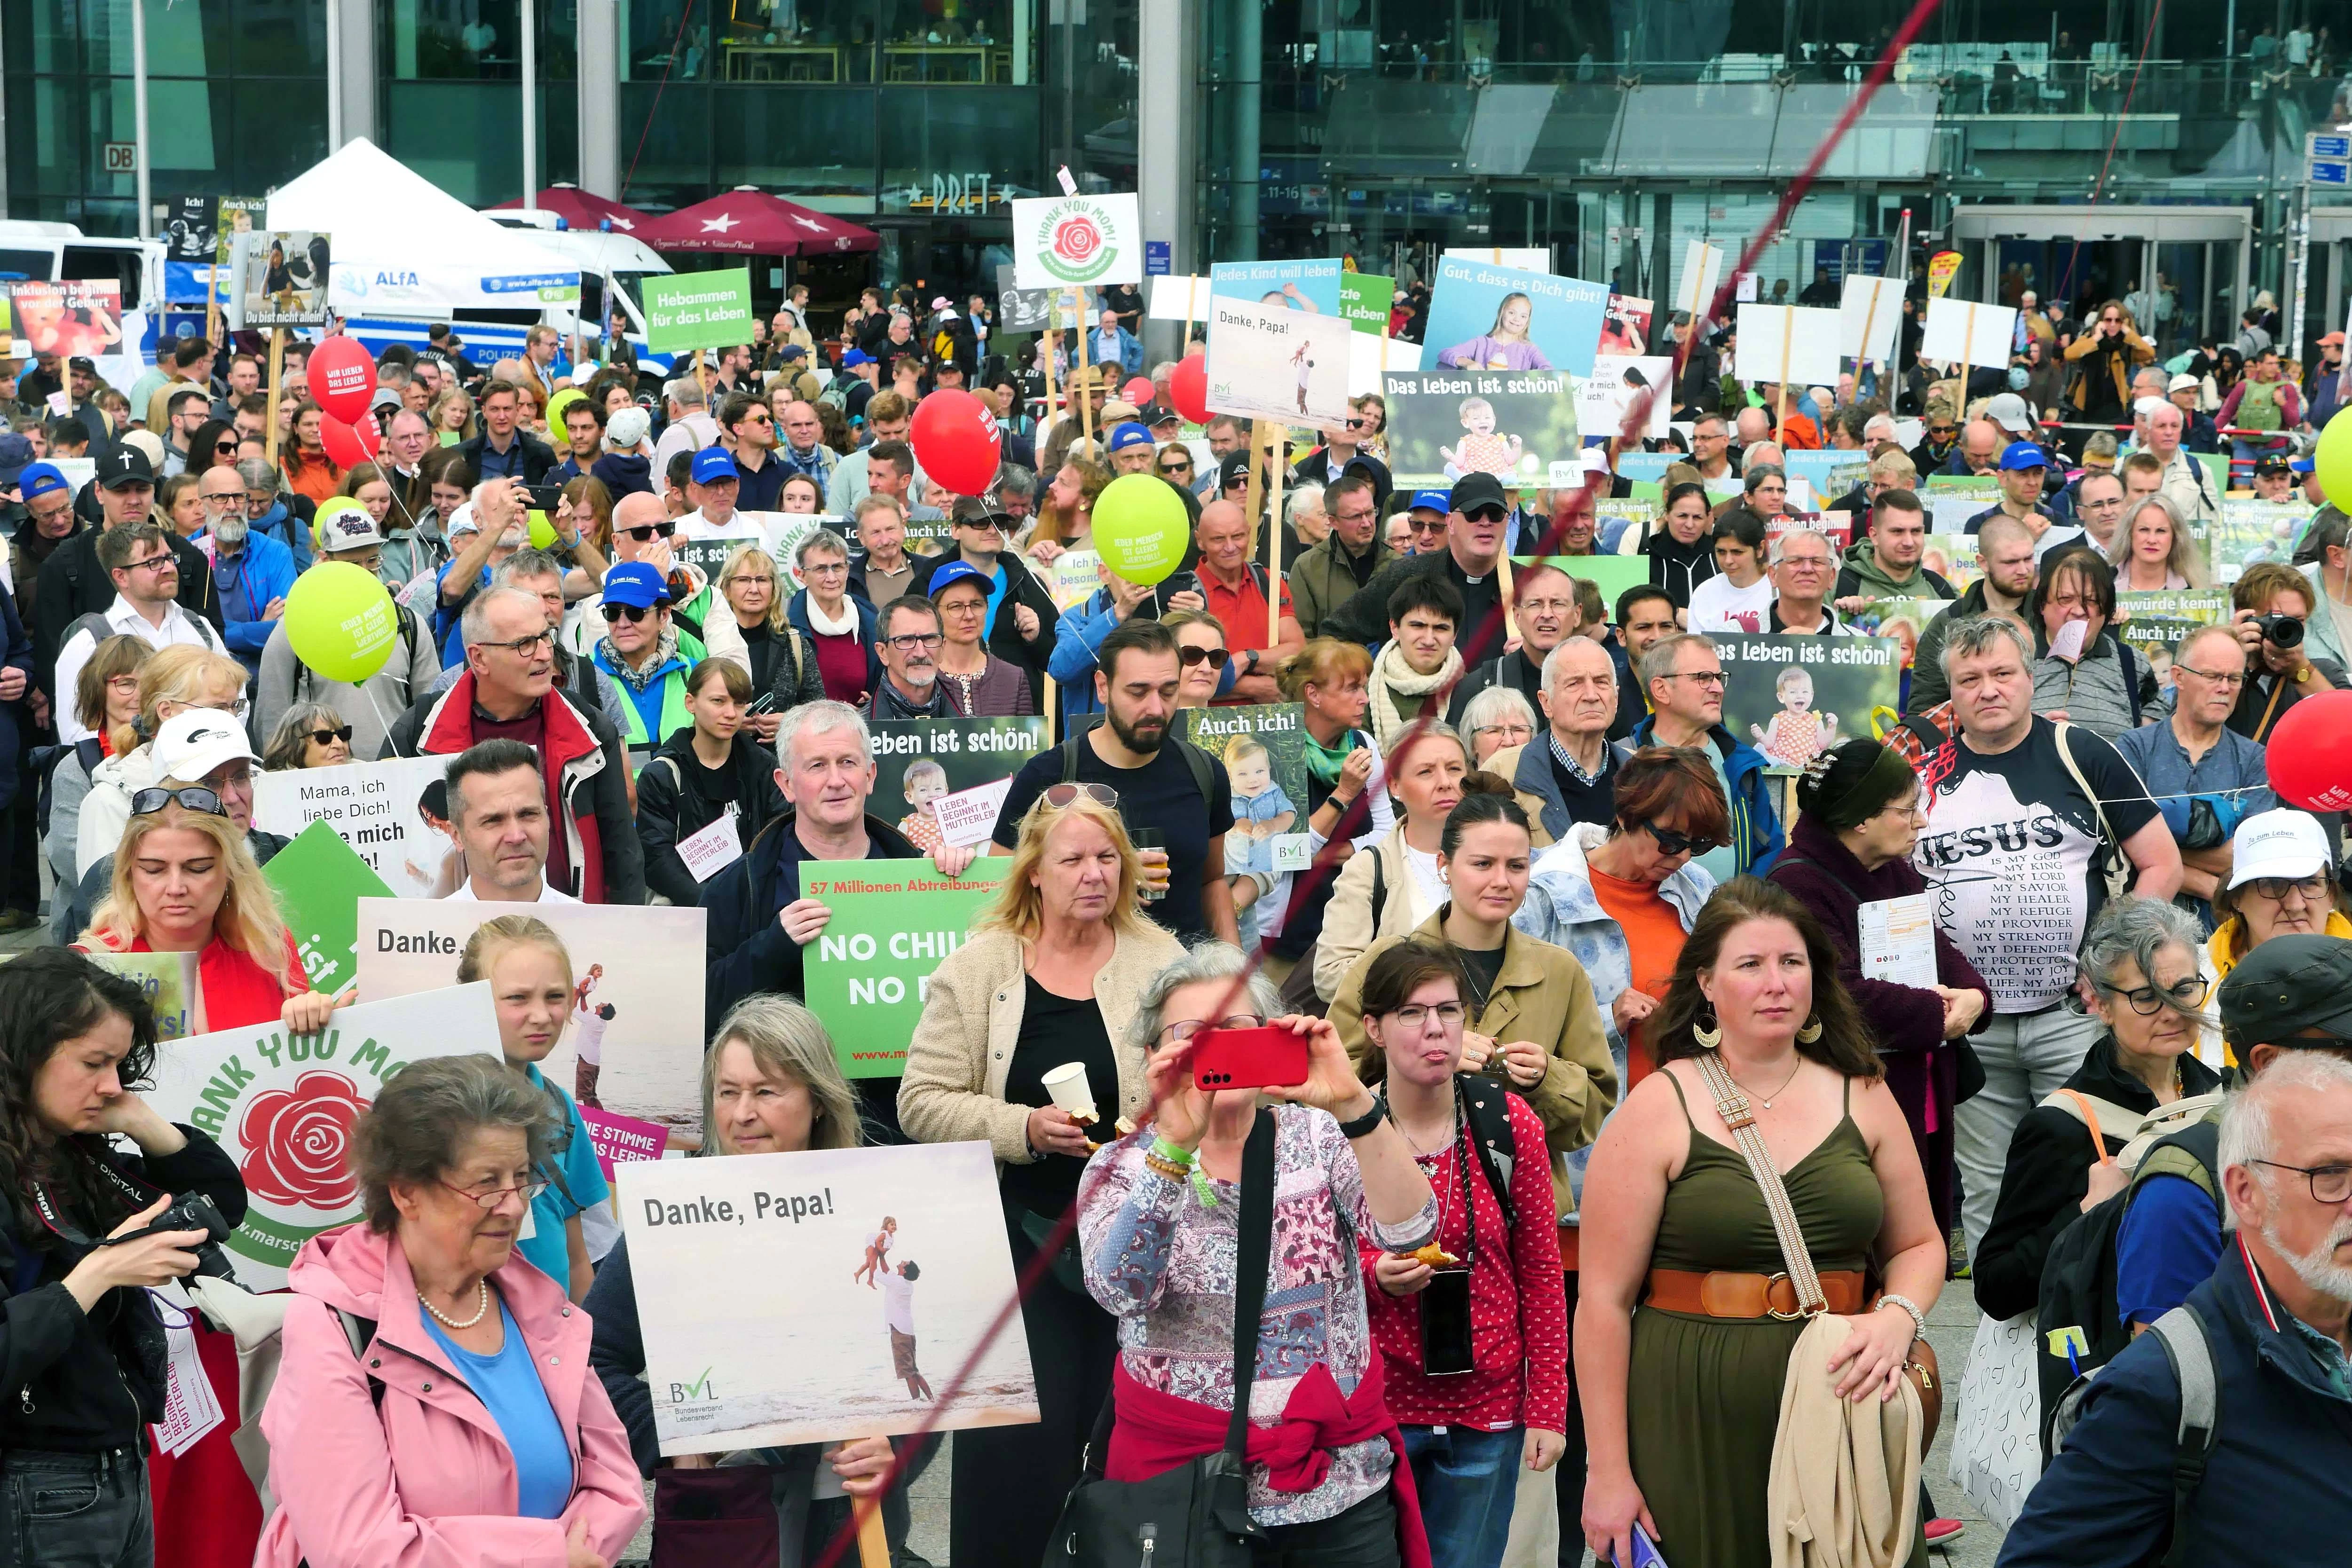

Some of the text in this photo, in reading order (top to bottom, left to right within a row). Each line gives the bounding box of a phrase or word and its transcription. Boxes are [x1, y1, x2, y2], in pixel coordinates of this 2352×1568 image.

[109, 148, 133, 167] DB
[933, 173, 991, 214] PRET
[1269, 186, 1299, 199] 11-16
[185, 197, 204, 207] Ich!
[222, 201, 265, 211] Auch ich!
[1038, 200, 1116, 245] THANK YOU MOM!
[376, 272, 419, 286] ALfA
[1215, 265, 1336, 281] Jedes Kind will leben
[12, 284, 66, 296] Inklusion
[1444, 265, 1601, 304] Gut, dass es Dich gibt!
[45, 298, 64, 308] der
[67, 297, 110, 308] Geburt
[658, 289, 737, 307] Hebammen
[1610, 297, 1648, 313] beginnt
[246, 309, 324, 323] Du bist nicht allein!
[652, 306, 745, 327] für das Leben
[1347, 306, 1385, 321] Leben
[1605, 308, 1641, 324] Geburt
[1220, 311, 1289, 334] Danke, Papa!
[479, 350, 523, 360] POLIZEI
[327, 366, 363, 378] WIR LIEBEN
[329, 376, 365, 388] DAS LEBEN!
[1388, 376, 1564, 394] Das Leben ist schön!
[1597, 381, 1616, 390] mich
[1619, 457, 1670, 466] Jedes Kind
[1790, 453, 1861, 464] Jedes Kind will
[1974, 489, 2003, 500] kennt
[1620, 502, 1652, 513] kennt
[1764, 517, 1847, 533] nklusion beginnt
[2223, 515, 2273, 525] kein Alter
[903, 525, 933, 537] Auch
[1114, 531, 1163, 547] JEDER MENSCH
[685, 546, 703, 563] ist
[1123, 543, 1159, 556] IST GLEICH
[1073, 558, 1089, 569] Ich
[1124, 552, 1160, 564] WERTVOLL!
[2179, 597, 2222, 610] kennt
[340, 598, 386, 632] JEDER MENSCH
[353, 613, 386, 638] IST GLEICH
[2126, 625, 2164, 640] Auch
[356, 623, 389, 648] WERTVOLL!
[1714, 641, 1890, 666] as Leben ist schön!
[1197, 714, 1296, 735] Auch ich!
[871, 726, 1038, 755] eben ist schön!
[300, 779, 385, 801] Mama, ich
[2329, 785, 2348, 799] WIR
[939, 797, 968, 812] LEBEN
[2318, 792, 2338, 806] DAS
[303, 801, 391, 823] liebe Dich!
[943, 801, 990, 821] BEGINNT IM
[945, 810, 995, 831] MUTTERLEIB
[357, 821, 404, 845] mich
[682, 837, 702, 854] LEBEN
[686, 835, 722, 861] BEGINNT IM
[1917, 814, 2065, 868] JESUS
[690, 840, 729, 868] MUTTERLEIB
[2008, 854, 2027, 863] MY
[2034, 851, 2061, 861] GOD
[2031, 862, 2063, 871] KING
[2032, 873, 2066, 881] LORD
[810, 880, 902, 894] 57 Millionen
[1993, 883, 2069, 892] MY SAVIOR
[1990, 895, 2071, 904] MY HEALER
[1990, 907, 2073, 916] MY REFUGE
[1975, 919, 2073, 929] MY PROVIDER
[1973, 931, 2073, 941] MY STRENGTH
[378, 929, 465, 959] Danke,
[820, 933, 877, 962] NO
[1977, 944, 2069, 953] MY DEFENDER
[298, 933, 339, 984] ist
[1969, 955, 2070, 965] MY PROTECTOR
[1975, 965, 2069, 976] PEACE. MY JOY
[1989, 976, 2069, 987] LIFE. MY ALL
[849, 977, 905, 1005] NO
[255, 1029, 340, 1068] YOU
[604, 1126, 656, 1151] STIMME
[100, 1163, 143, 1202] DIGITAL
[644, 1187, 835, 1227] Danke, Papa!
[167, 1361, 192, 1433] MUTTERLEIB
[674, 1404, 724, 1416] Bundesverband
[676, 1413, 715, 1423] Lebensrecht
